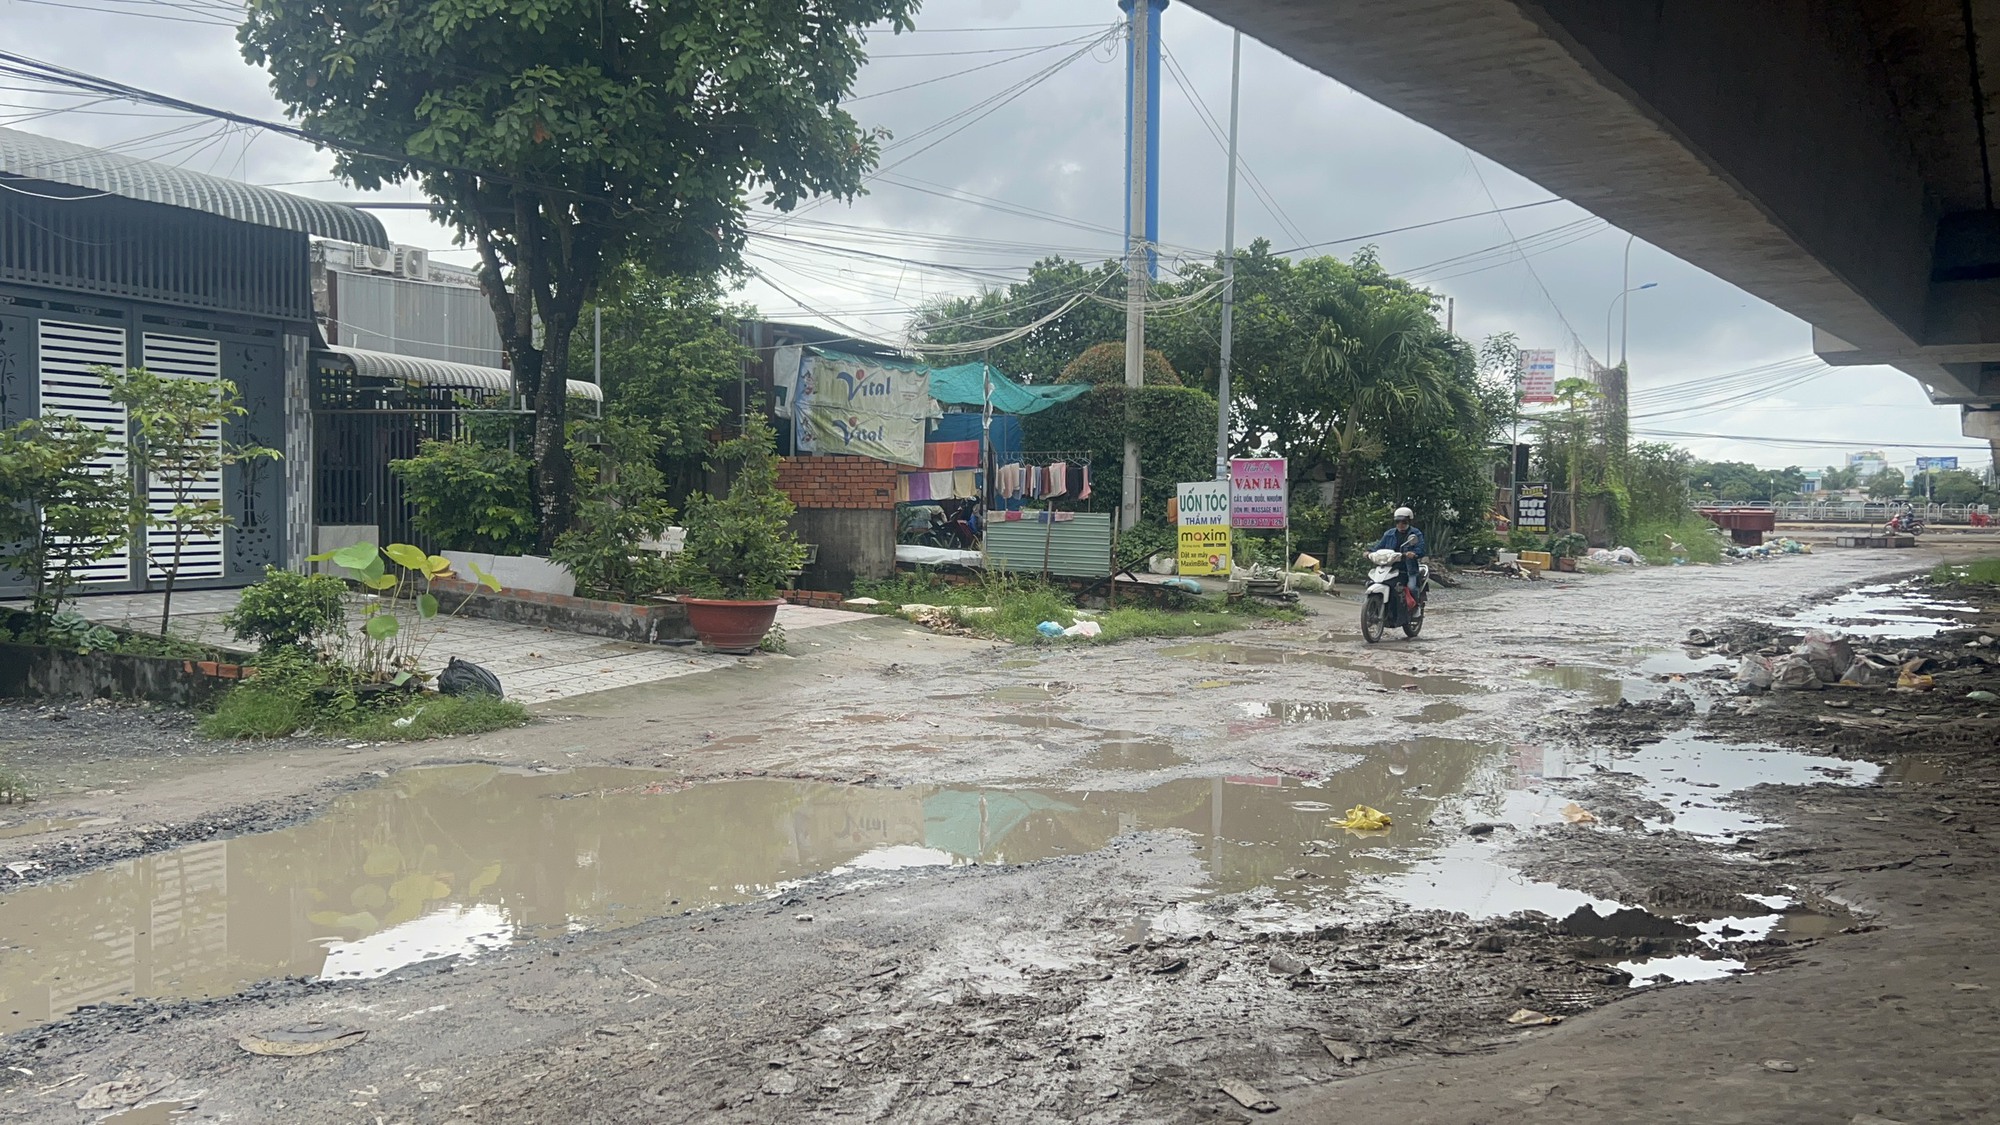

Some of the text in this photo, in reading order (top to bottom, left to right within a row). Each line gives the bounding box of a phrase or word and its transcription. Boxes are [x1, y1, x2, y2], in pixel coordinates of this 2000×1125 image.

[836, 369, 891, 400] Vital
[832, 416, 884, 446] Vital
[1264, 475, 1281, 489] HÀ
[1179, 487, 1227, 512] UỐN TÓC
[1519, 508, 1546, 516] TÓC
[1185, 513, 1222, 525] THẨM MỸ
[1518, 517, 1546, 525] NAM
[1181, 529, 1227, 541] maxim
